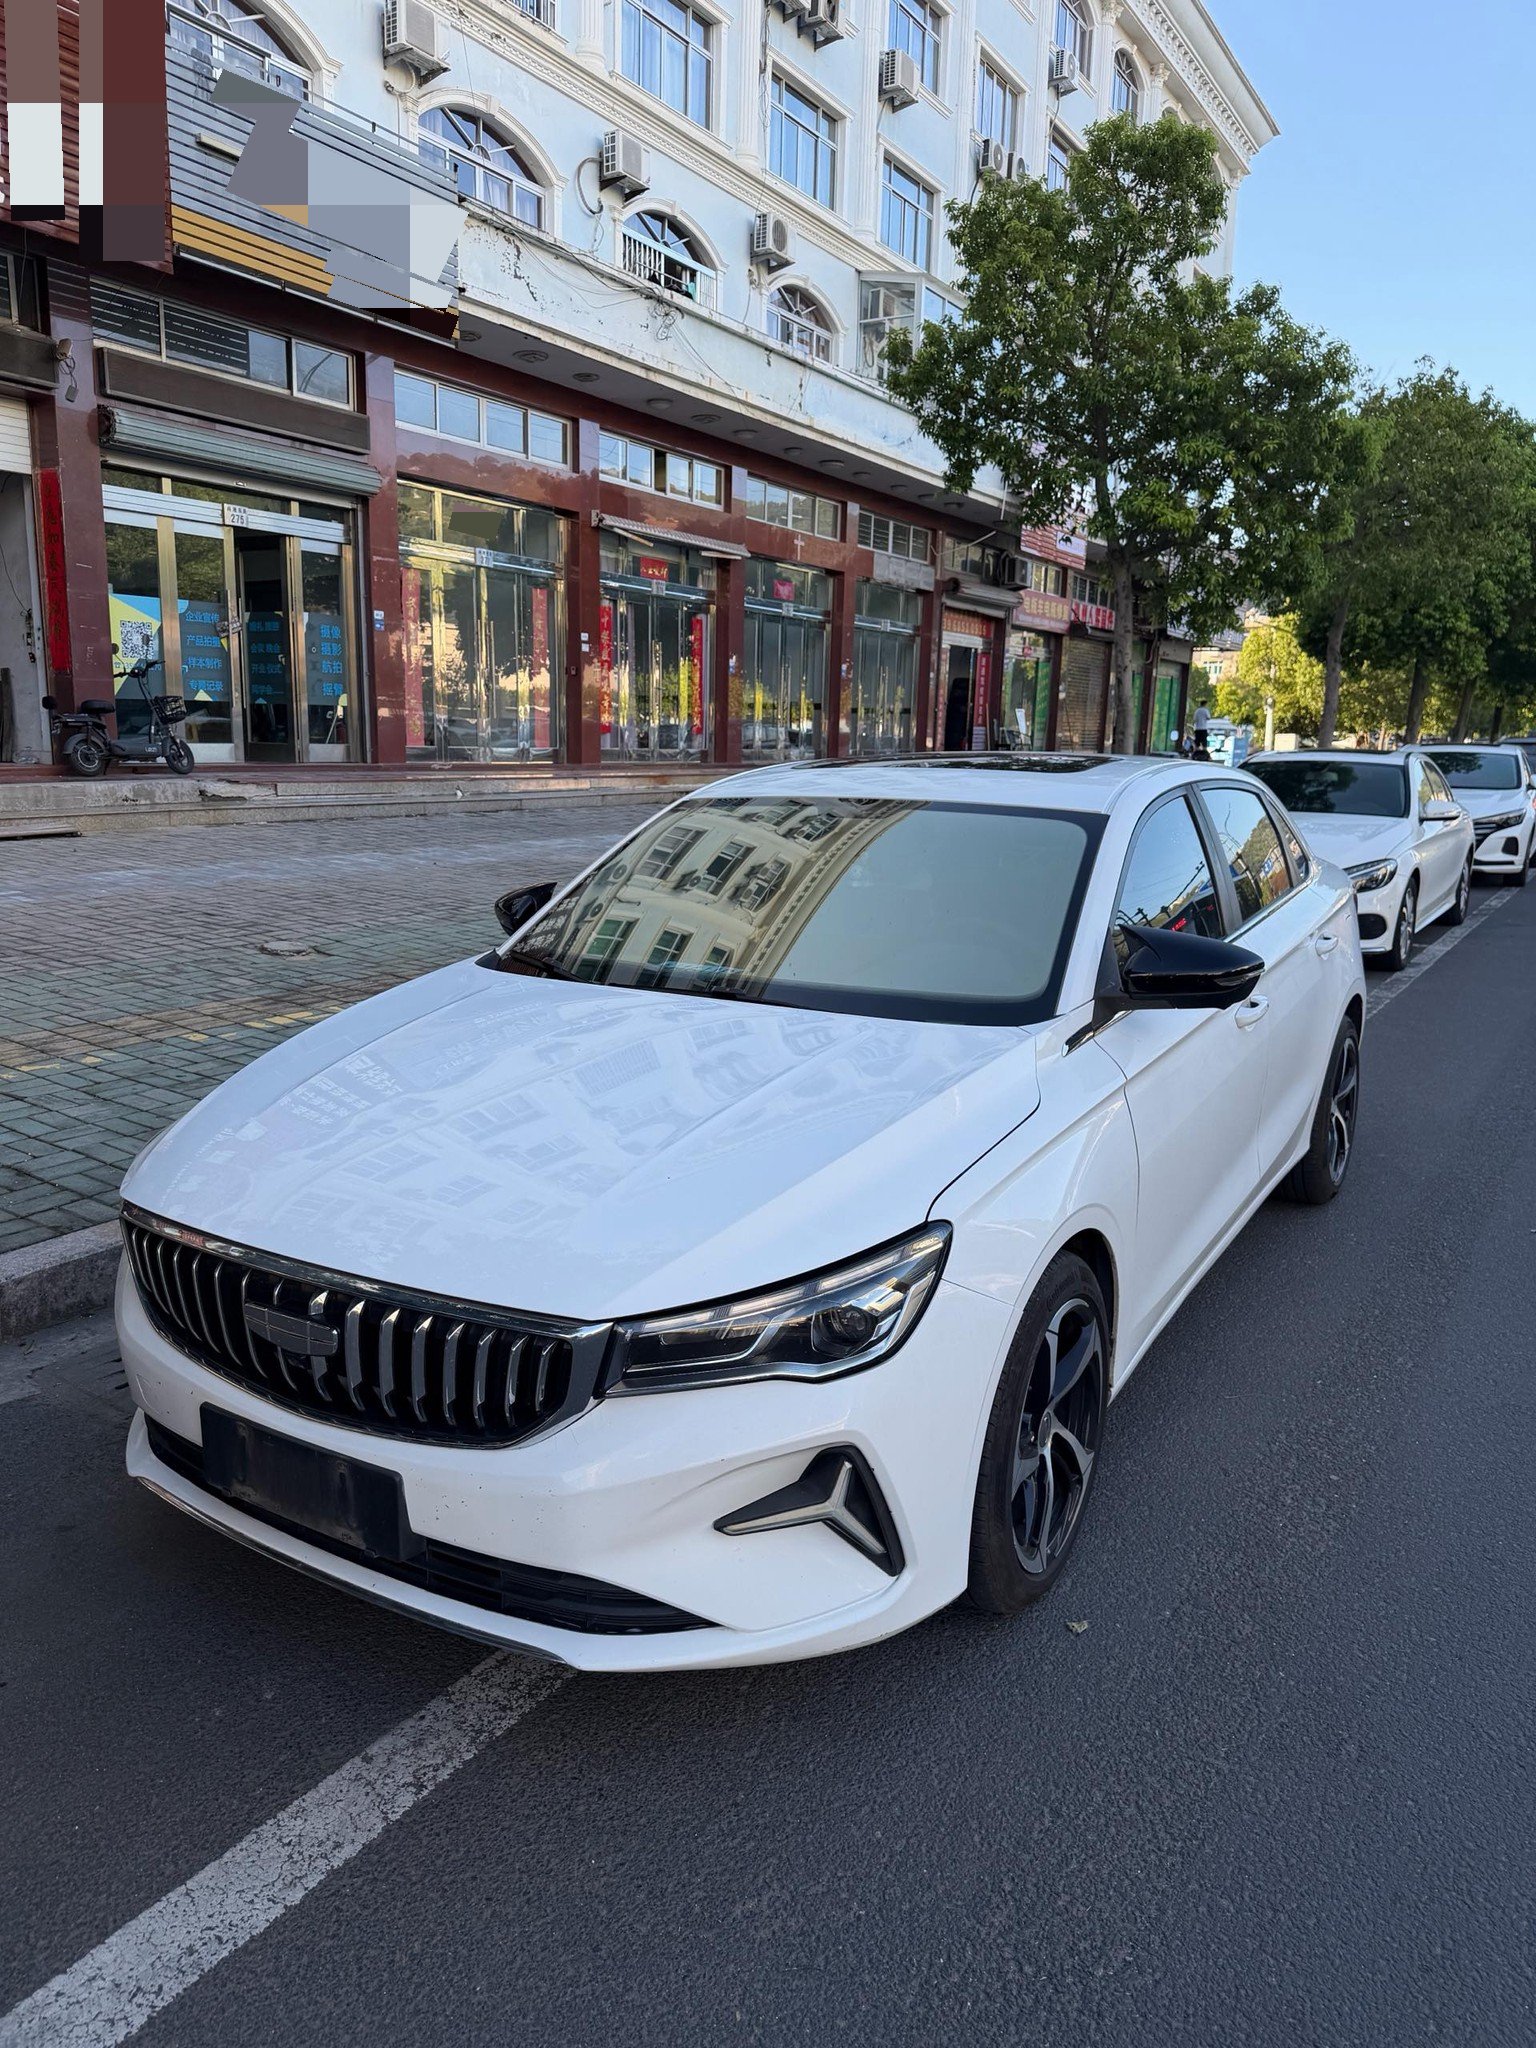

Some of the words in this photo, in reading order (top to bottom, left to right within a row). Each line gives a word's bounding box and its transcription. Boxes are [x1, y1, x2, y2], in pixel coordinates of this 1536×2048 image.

[231, 513, 245, 525] 275
[186, 635, 221, 648] 产品拍摄
[321, 660, 343, 674] 航拍
